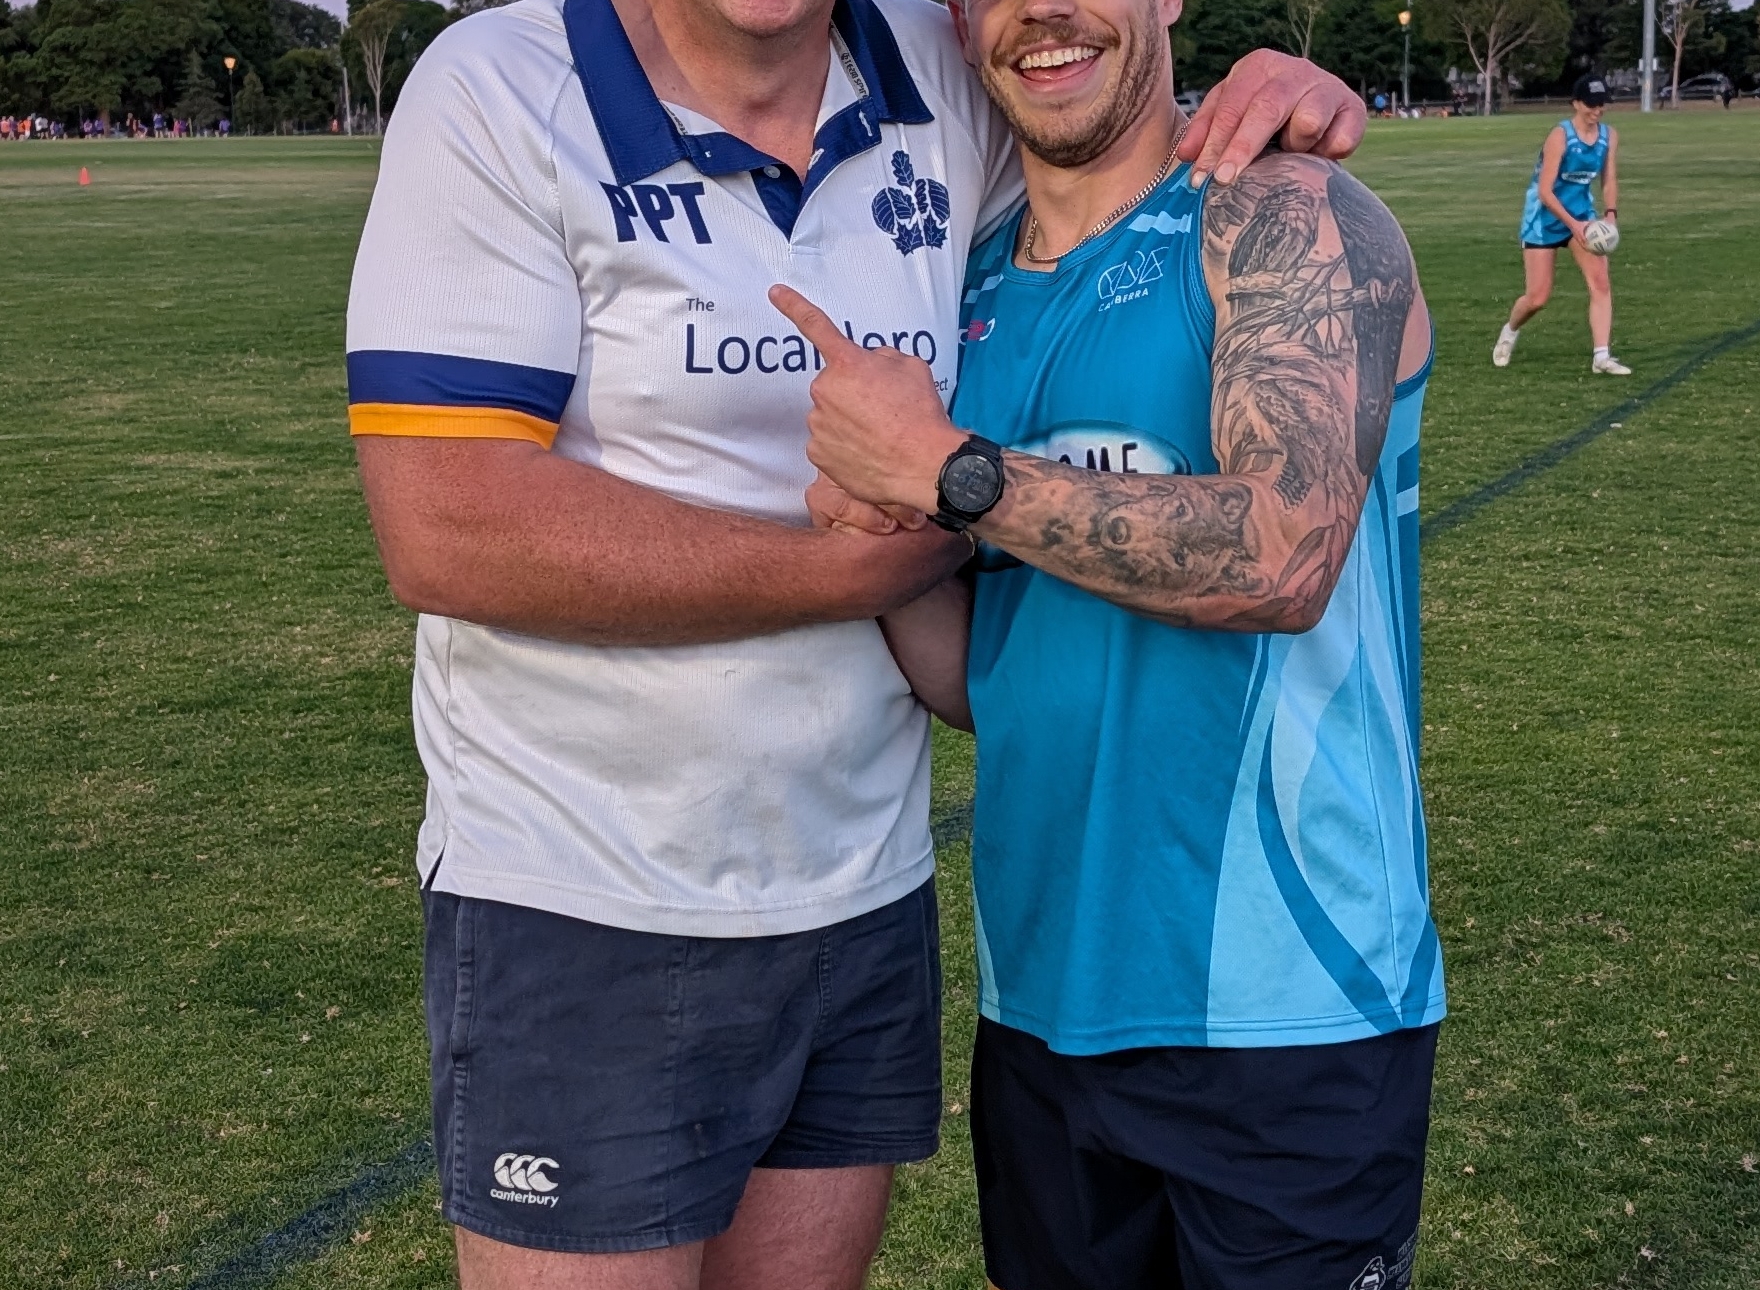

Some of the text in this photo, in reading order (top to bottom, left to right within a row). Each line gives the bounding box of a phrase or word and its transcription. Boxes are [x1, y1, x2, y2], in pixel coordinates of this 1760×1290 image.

[598, 181, 713, 245] PPT
[686, 297, 715, 312] The
[844, 320, 937, 366] ero
[490, 1189, 560, 1209] canterbury
